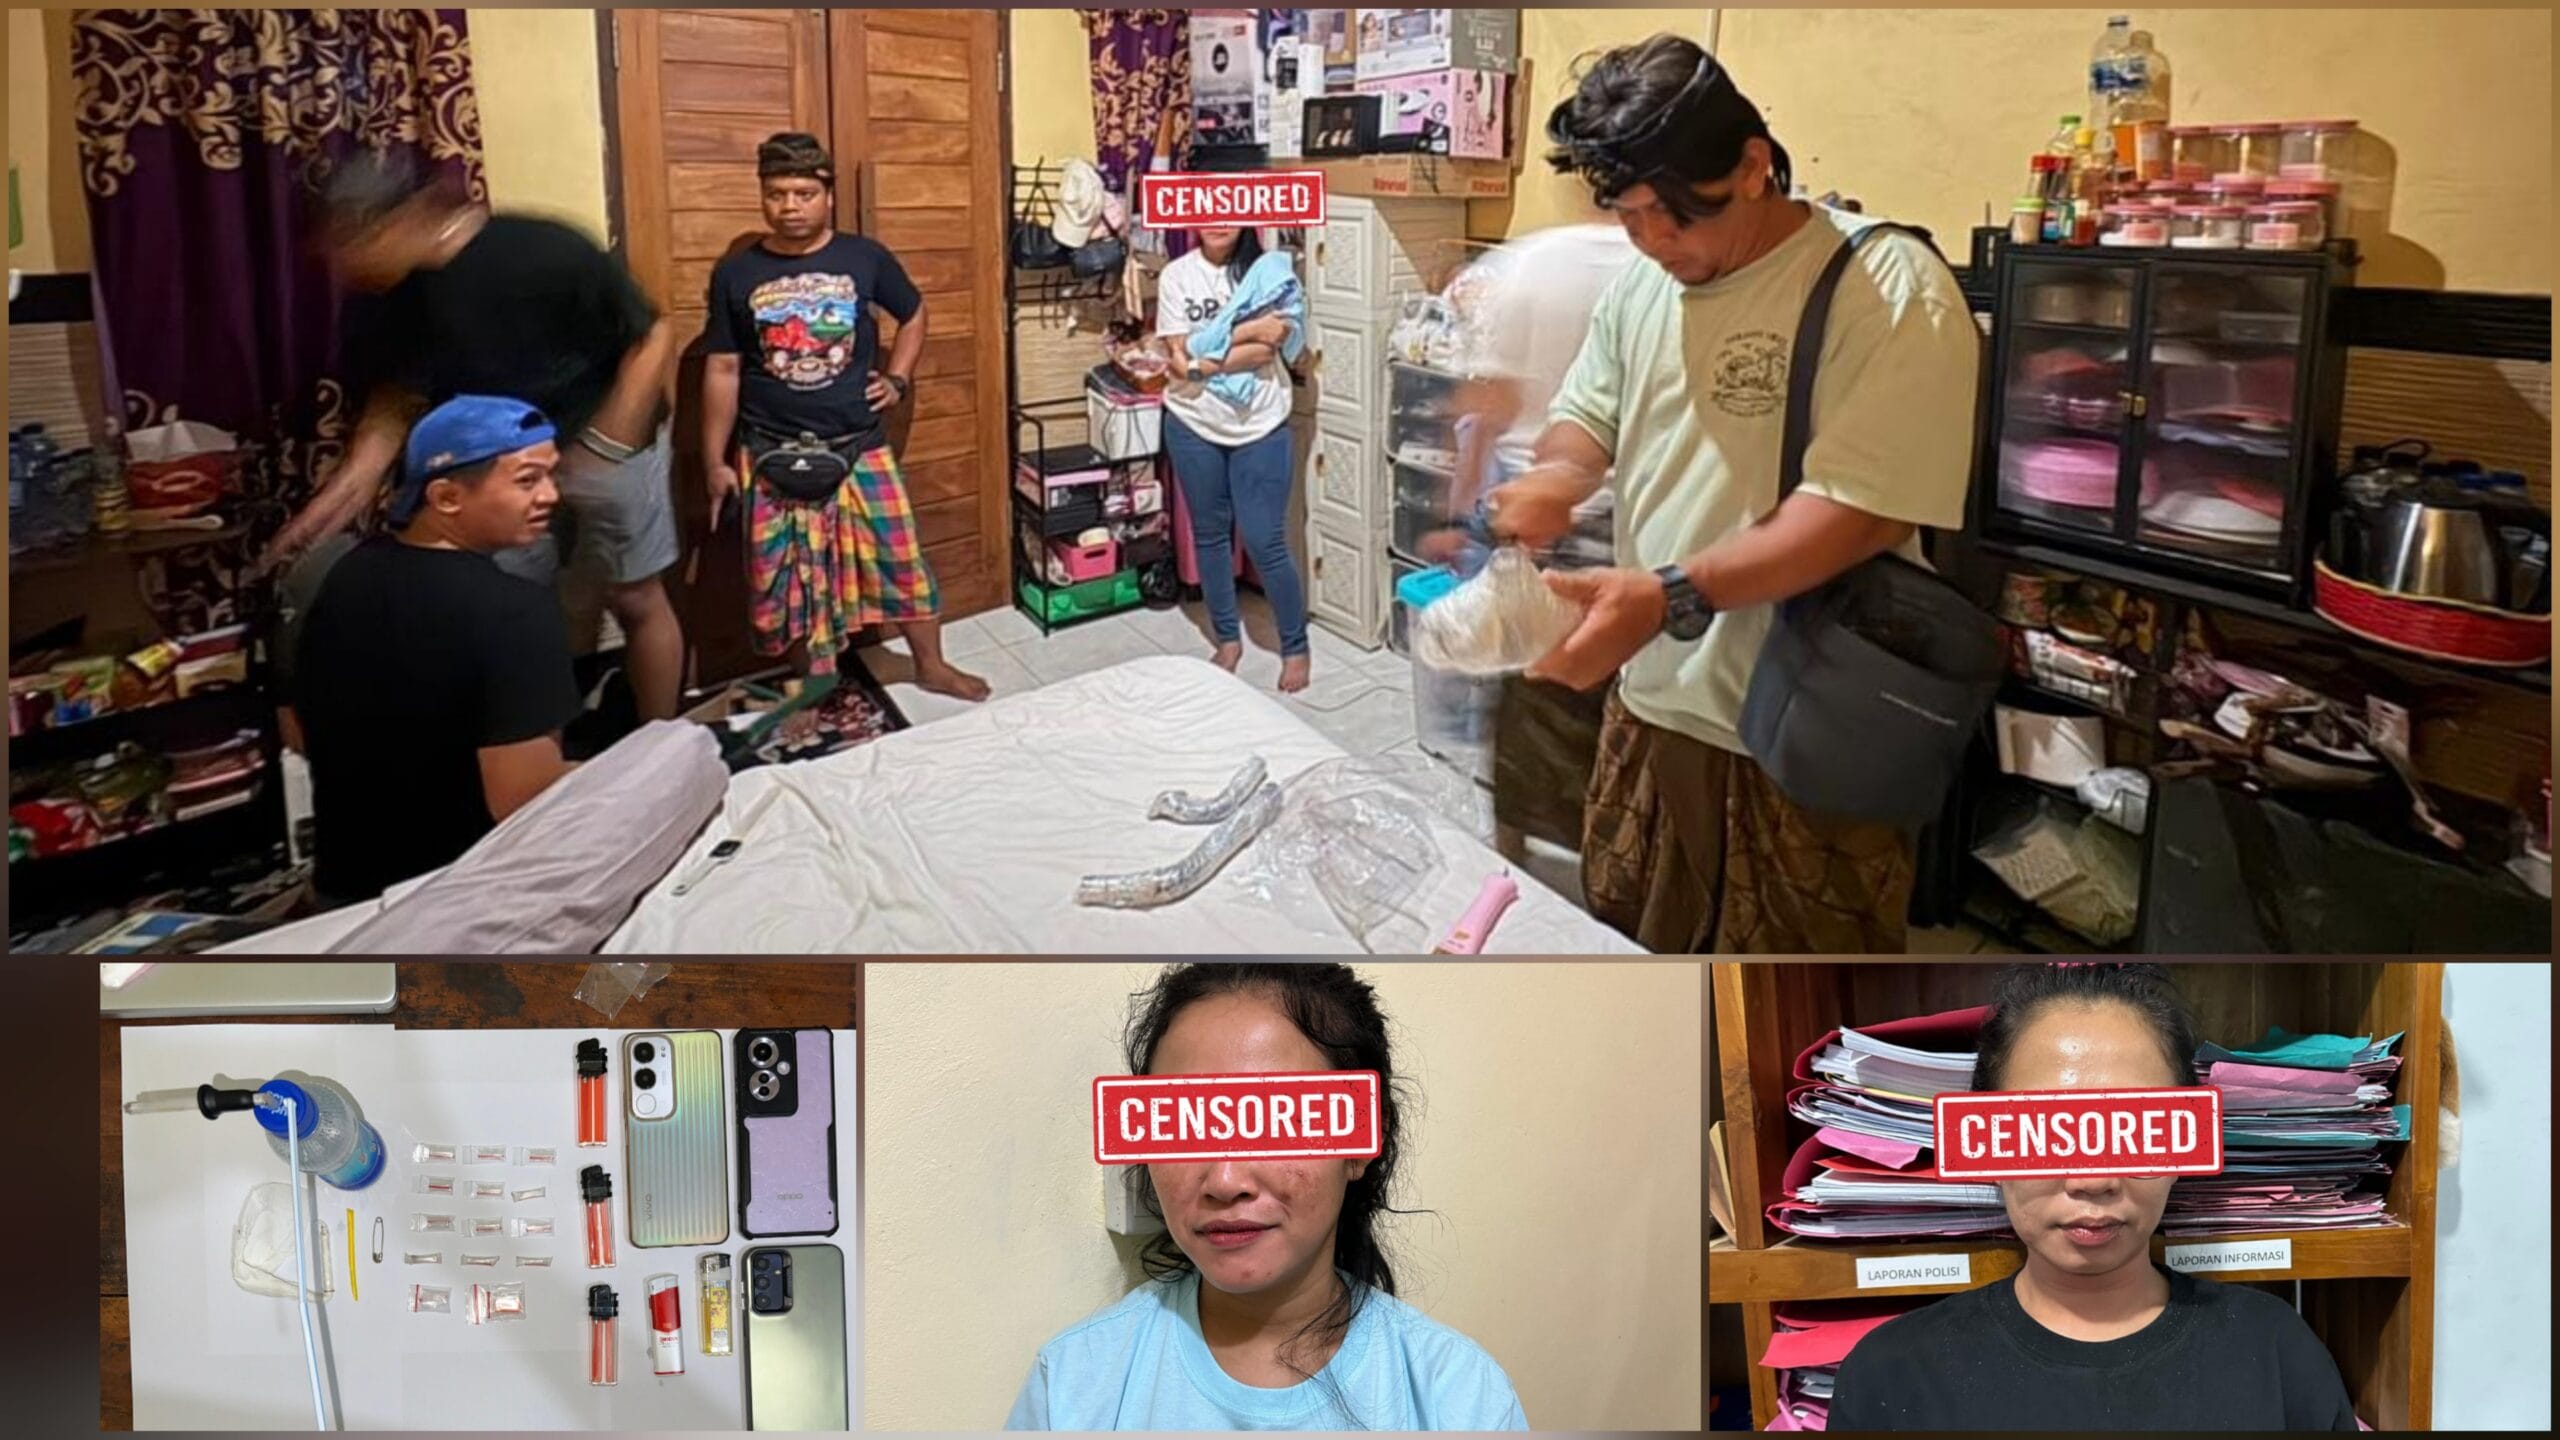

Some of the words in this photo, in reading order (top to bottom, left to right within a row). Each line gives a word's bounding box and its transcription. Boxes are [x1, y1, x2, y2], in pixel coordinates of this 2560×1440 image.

[2171, 1254, 2222, 1267] LAPORAN
[2224, 1250, 2285, 1264] INFORMASI
[1867, 1268, 1922, 1281] LAPORAN
[1925, 1266, 1960, 1277] POLISI
